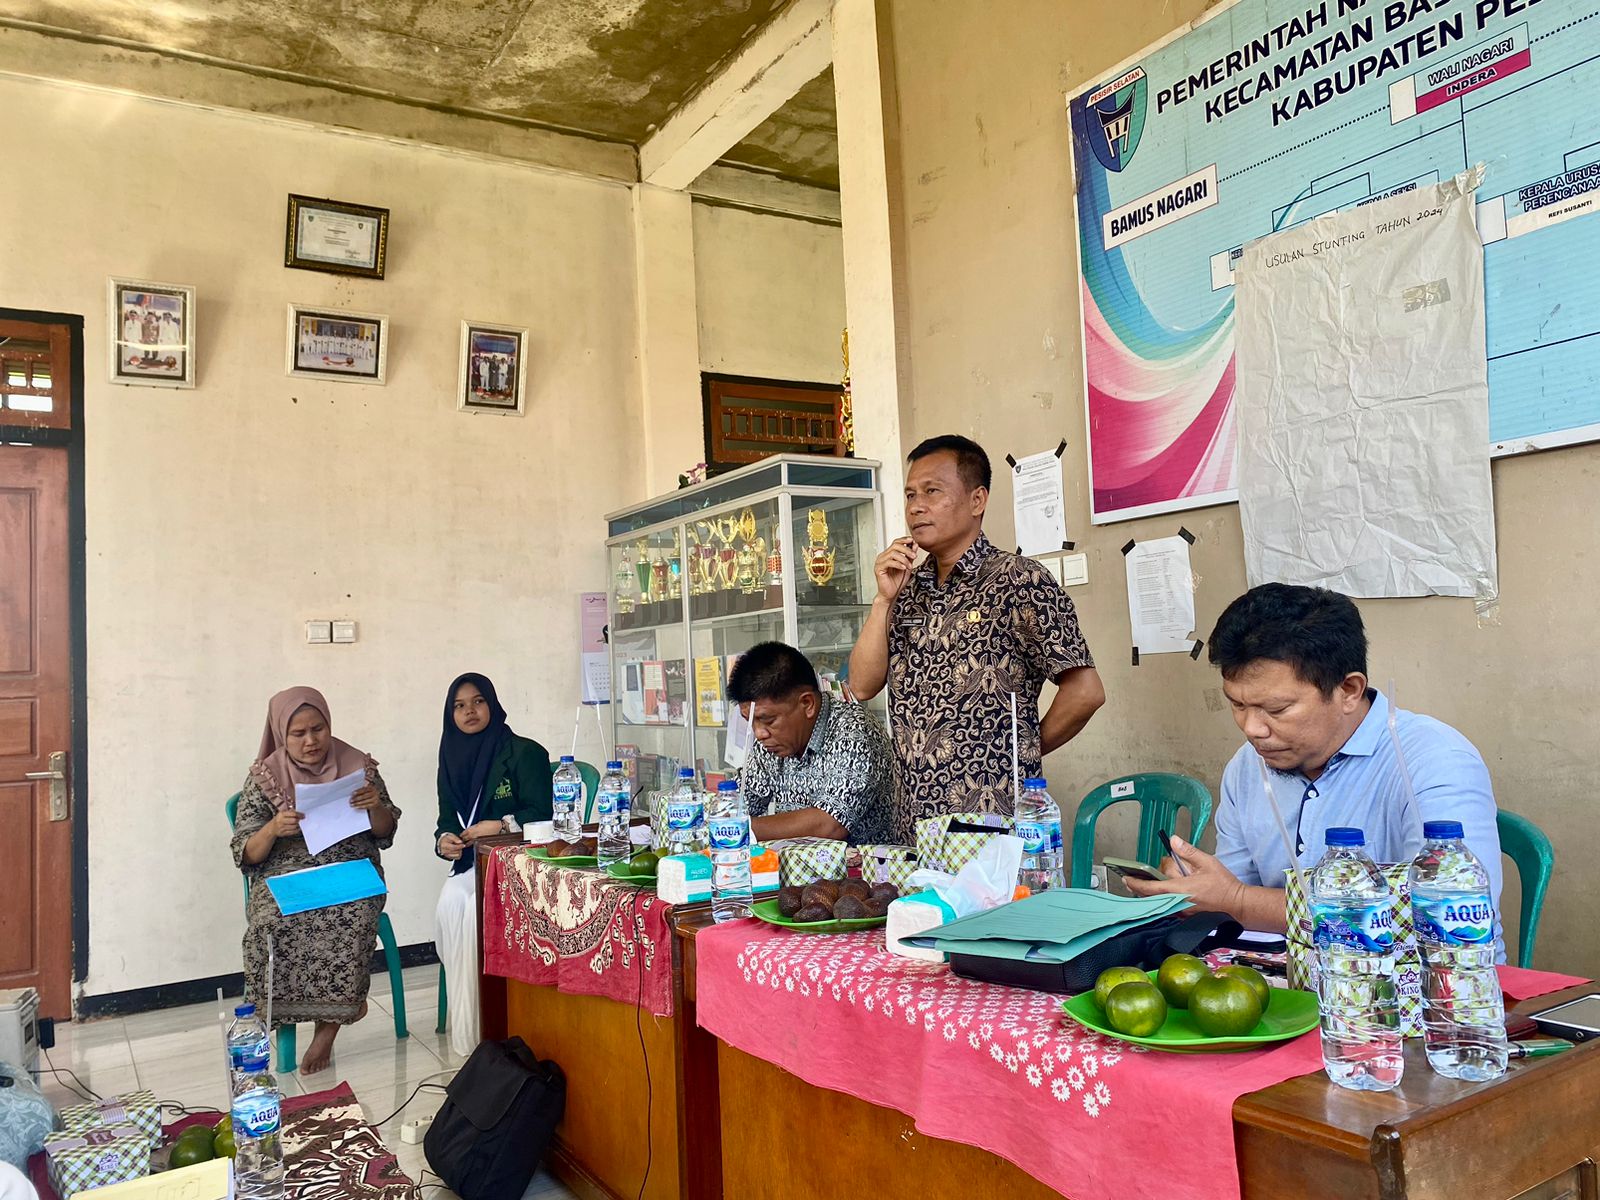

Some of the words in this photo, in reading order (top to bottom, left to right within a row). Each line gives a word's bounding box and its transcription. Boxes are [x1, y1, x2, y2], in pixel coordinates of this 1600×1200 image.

[1156, 2, 1328, 114] PEMERINTAH
[1205, 15, 1374, 124] KECAMATAN
[1272, 12, 1464, 127] KABUPATEN
[1475, 0, 1543, 31] PE
[1428, 62, 1460, 86] WALI
[1462, 37, 1514, 72] NAGARI
[1090, 86, 1113, 103] PESISIR
[1113, 70, 1140, 91] SELATAN
[1447, 68, 1496, 97] INDERA
[1519, 176, 1565, 201] KEPALA
[1565, 163, 1600, 186] URUS
[1110, 203, 1155, 238] BAMUS
[1157, 179, 1208, 218] NAGARI
[1548, 210, 1563, 218] REFI
[1564, 200, 1592, 213] SUSANTI
[1265, 248, 1305, 268] USULAN
[1312, 230, 1366, 255] STUNTING
[1375, 216, 1411, 235] TAHUN
[1416, 207, 1443, 221] 2024
[556, 785, 575, 794] AQUA
[714, 826, 741, 838] AQUA
[1444, 903, 1490, 924] AQUA
[250, 1106, 278, 1124] AQUA
